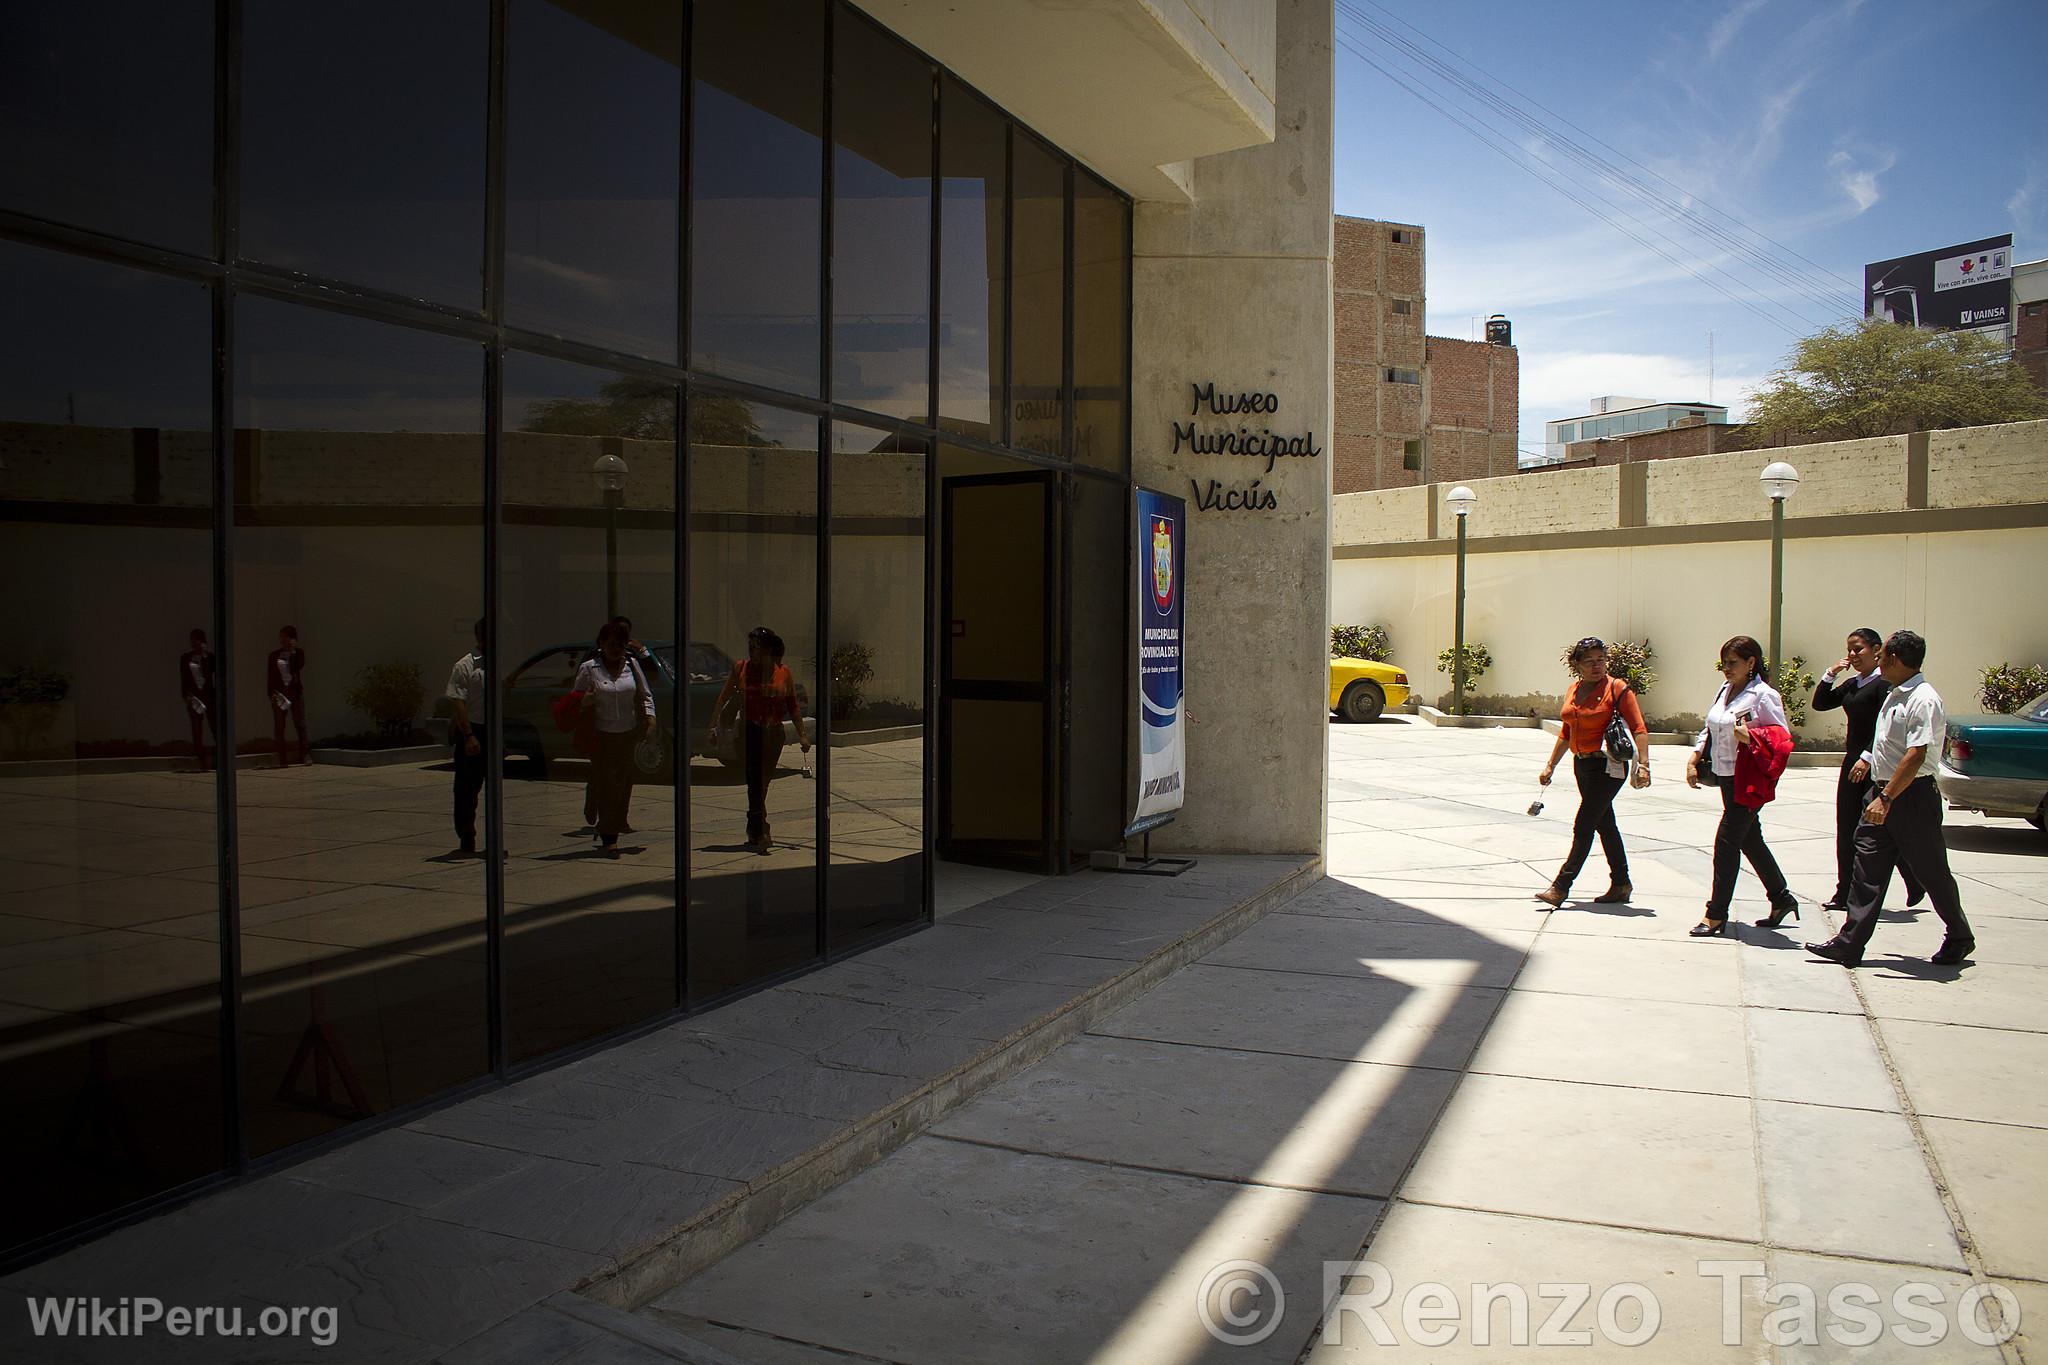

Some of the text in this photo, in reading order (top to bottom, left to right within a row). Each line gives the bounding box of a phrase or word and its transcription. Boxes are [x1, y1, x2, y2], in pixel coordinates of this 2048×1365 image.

[1977, 274, 1989, 282] vive
[1973, 306, 2006, 319] VAINSA
[1191, 382, 1279, 416] Museo
[1172, 421, 1322, 474] Municipal
[1190, 479, 1278, 512] Vicús
